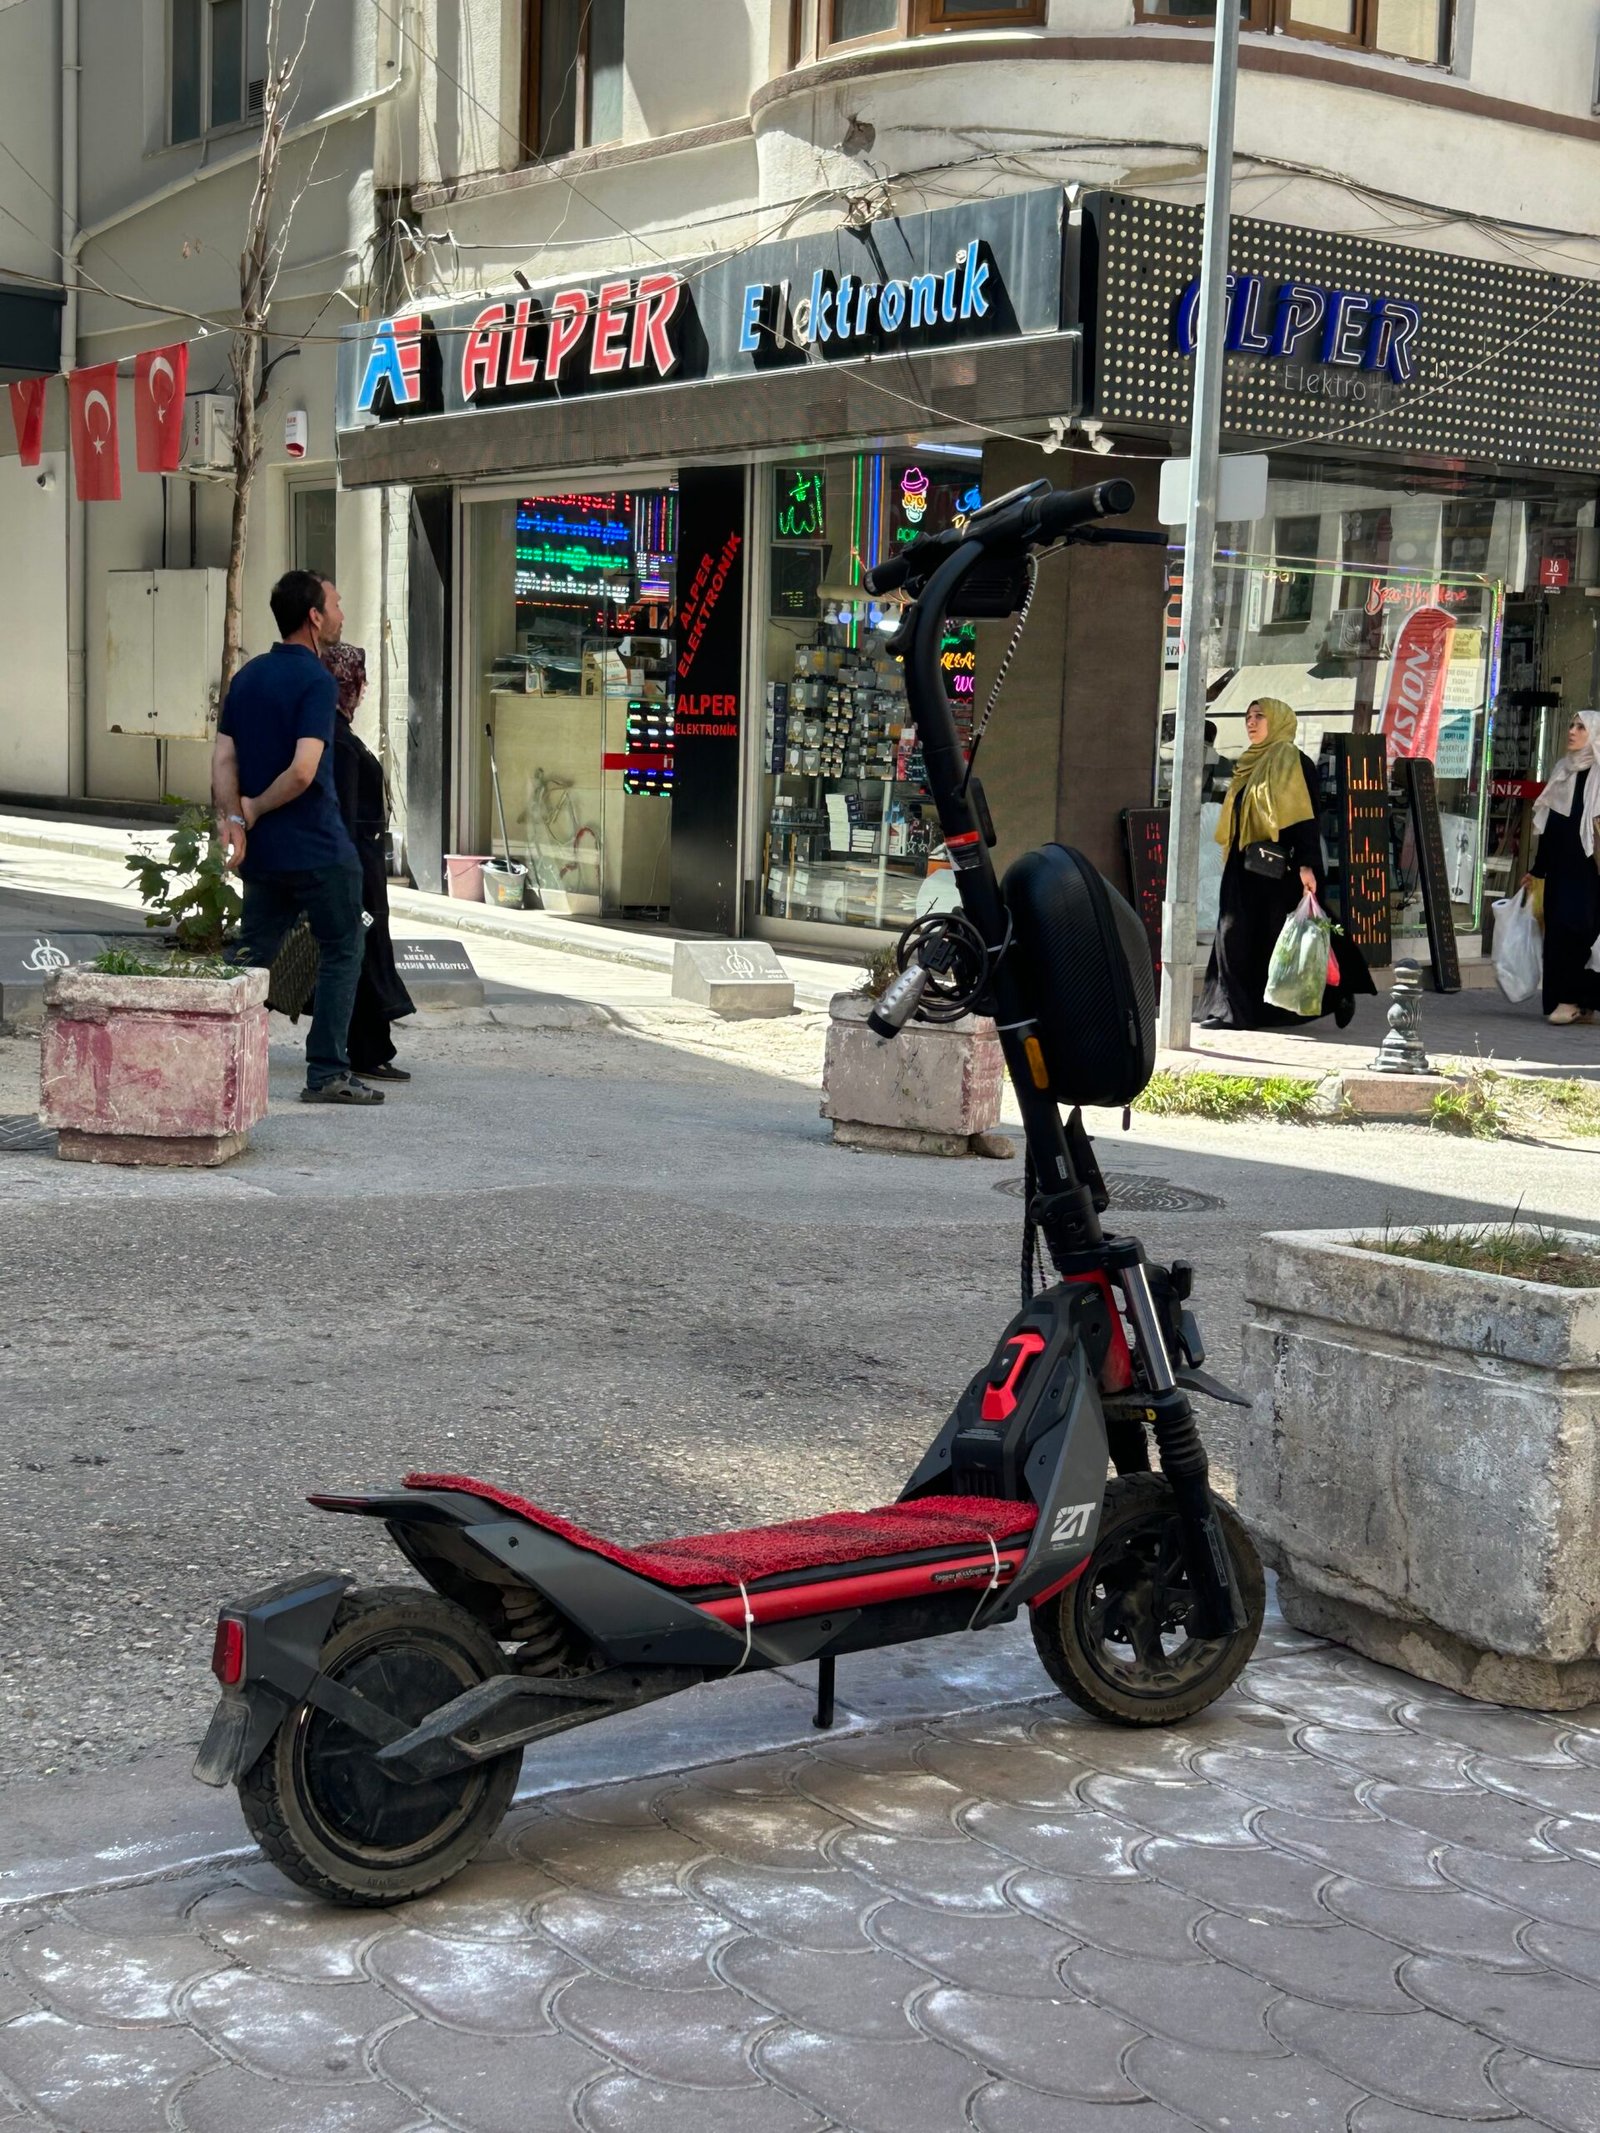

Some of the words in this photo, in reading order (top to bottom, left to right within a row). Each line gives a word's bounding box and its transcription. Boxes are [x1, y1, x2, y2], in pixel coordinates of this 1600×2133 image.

[461, 272, 681, 402] ALPER
[1550, 560, 1559, 572] 16
[680, 553, 715, 631] ALPER
[676, 694, 737, 717] ALPER
[675, 722, 738, 737] ELEKTRONİK
[1491, 780, 1522, 796] İNİZ
[403, 953, 436, 961] ANKARA
